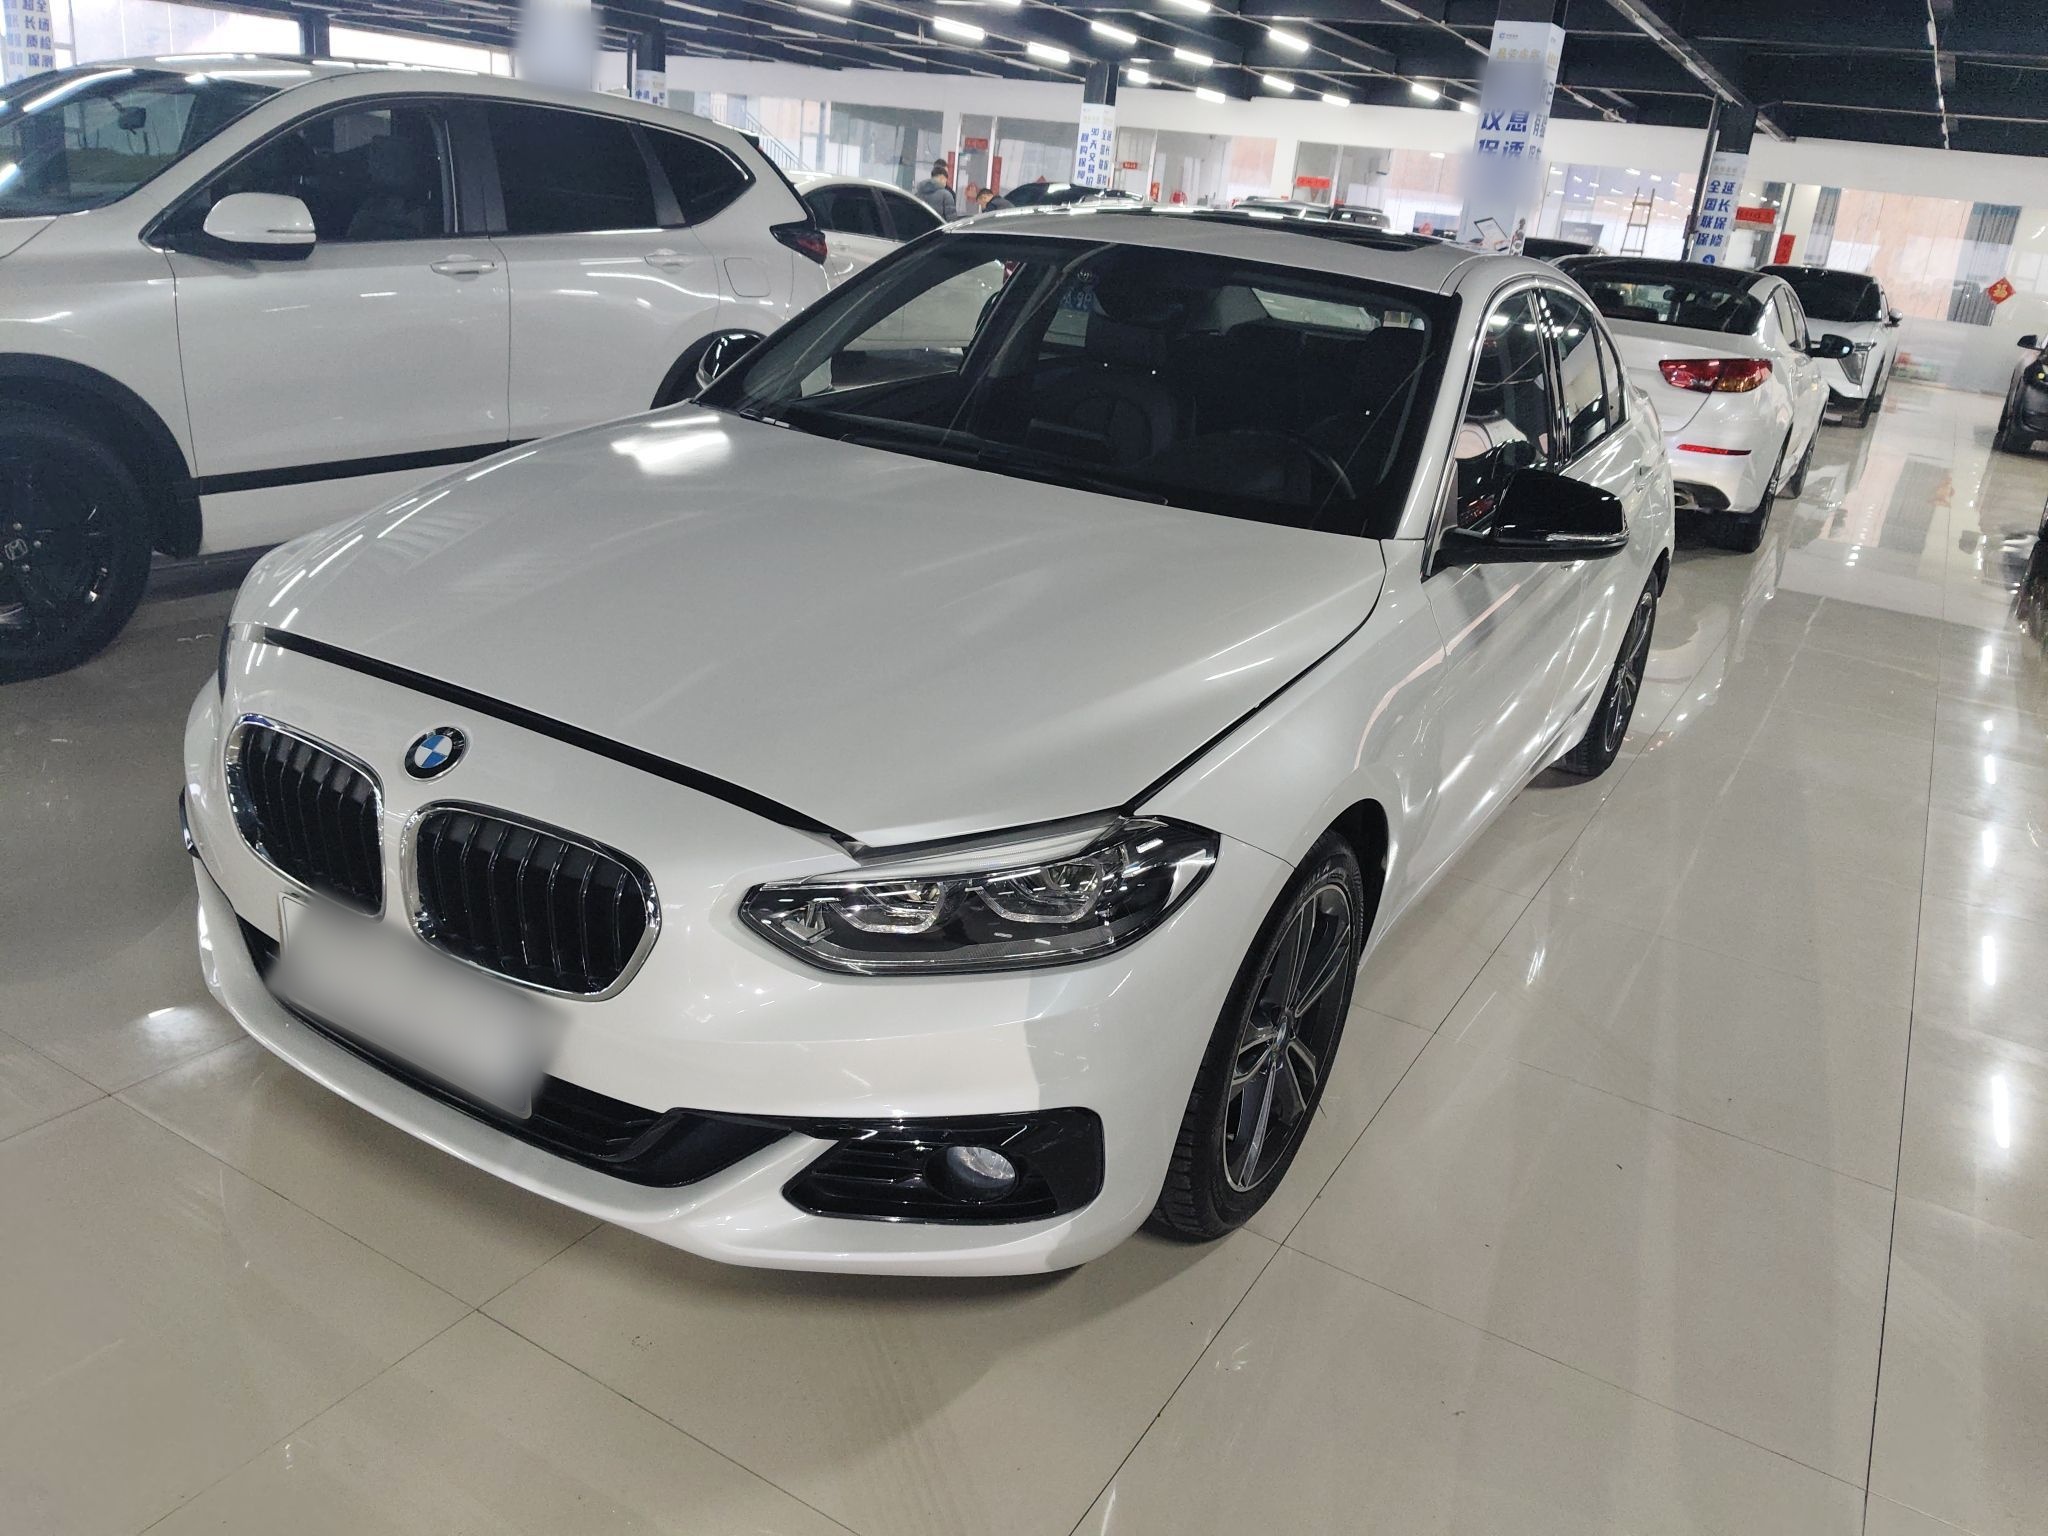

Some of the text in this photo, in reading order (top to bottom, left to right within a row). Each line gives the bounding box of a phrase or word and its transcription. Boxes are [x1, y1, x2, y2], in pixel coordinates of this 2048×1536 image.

[1696, 179, 1721, 247] 全国联保
[1709, 181, 1736, 247] 延长保修
